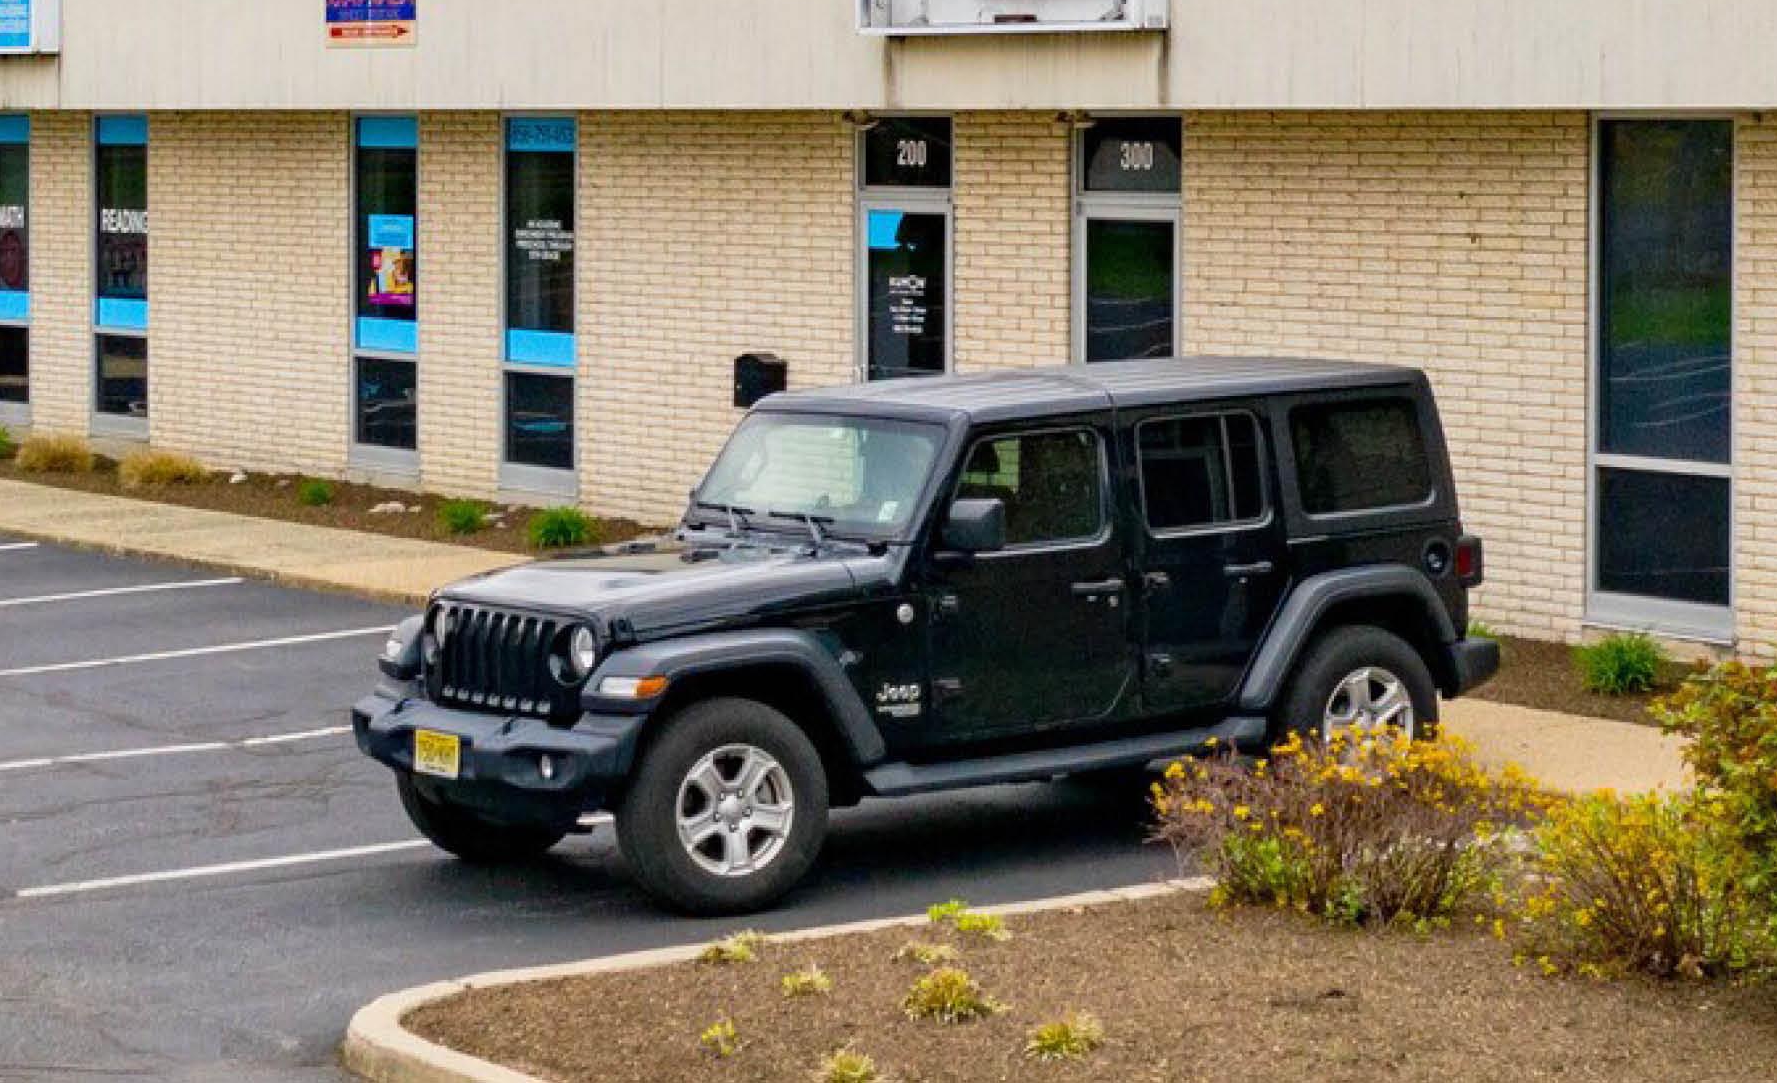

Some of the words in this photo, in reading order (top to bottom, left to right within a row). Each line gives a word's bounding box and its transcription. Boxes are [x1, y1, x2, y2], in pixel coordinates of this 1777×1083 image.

[896, 139, 927, 166] 200
[1120, 141, 1154, 171] 300
[876, 682, 920, 702] Jeep
